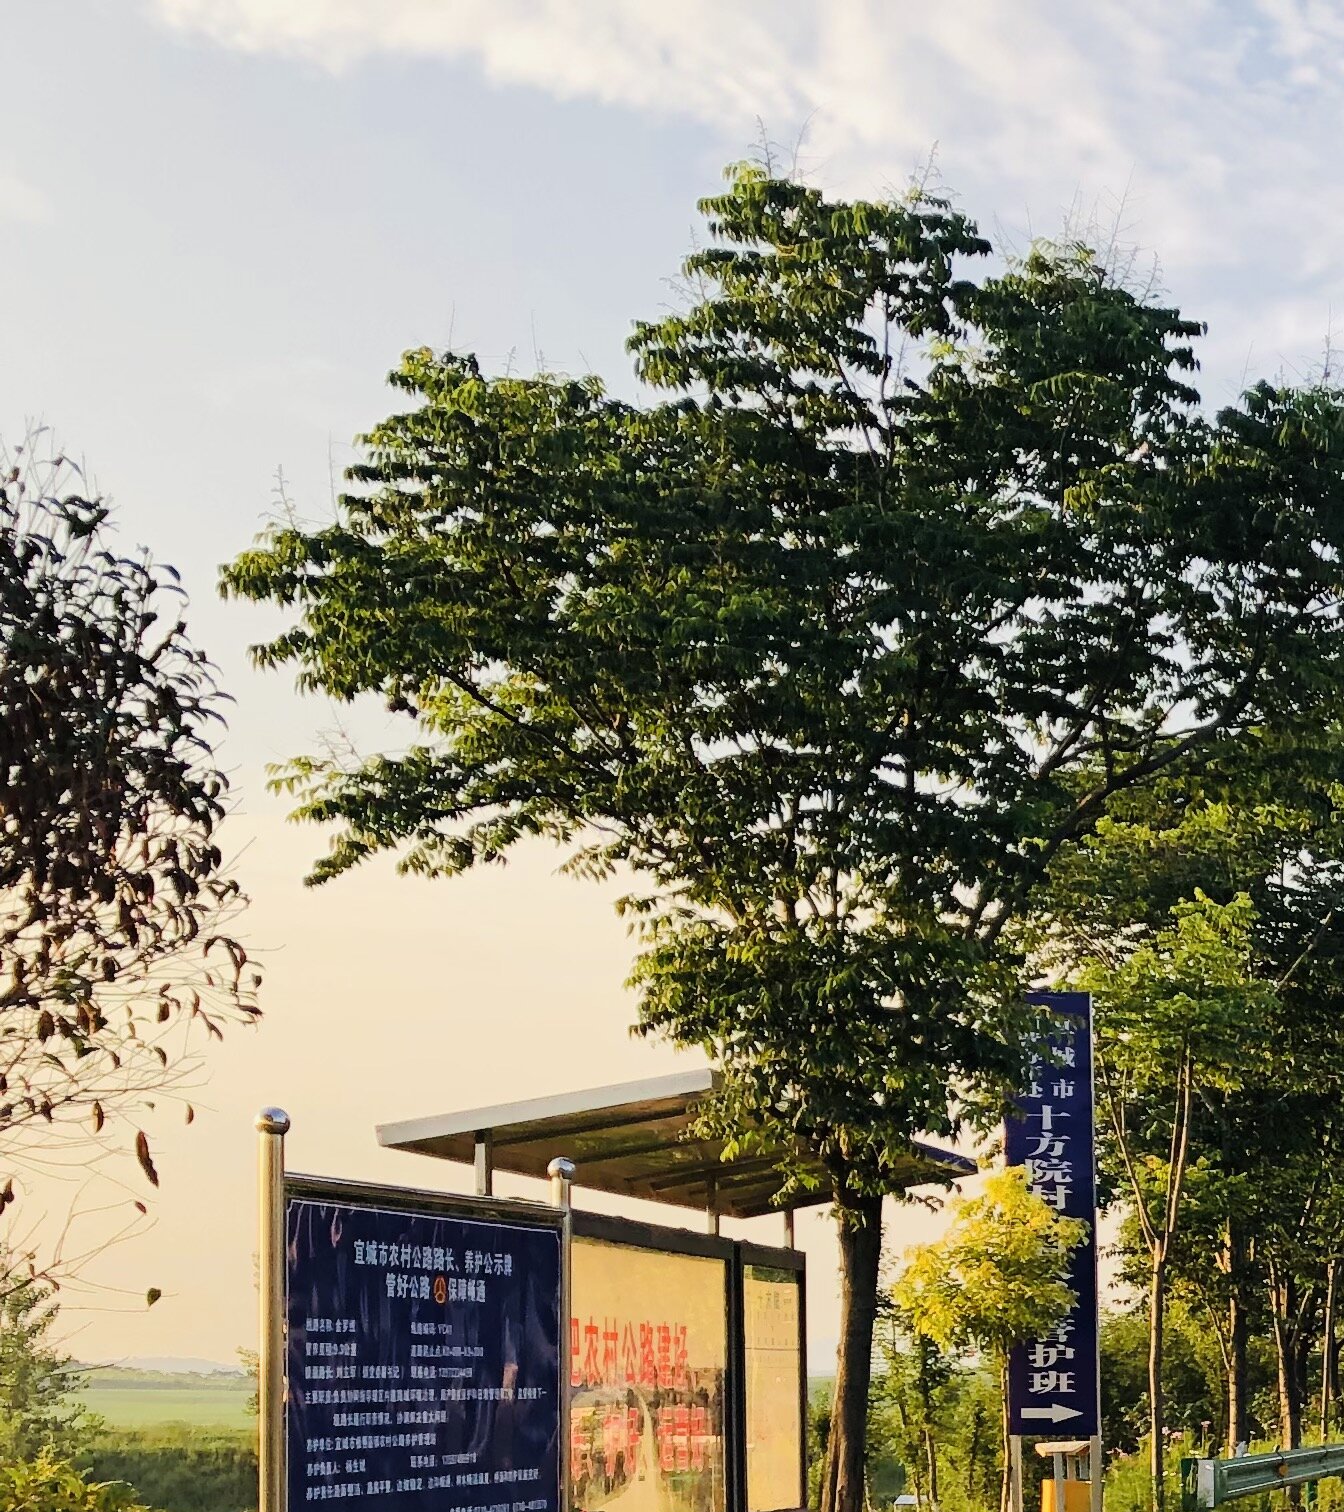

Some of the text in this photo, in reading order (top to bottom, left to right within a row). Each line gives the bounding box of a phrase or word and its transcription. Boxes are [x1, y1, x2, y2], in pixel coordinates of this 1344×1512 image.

[353, 1239, 513, 1277] 宜城市农村公路路长、养护公示牌
[385, 1272, 431, 1300] 管好公路
